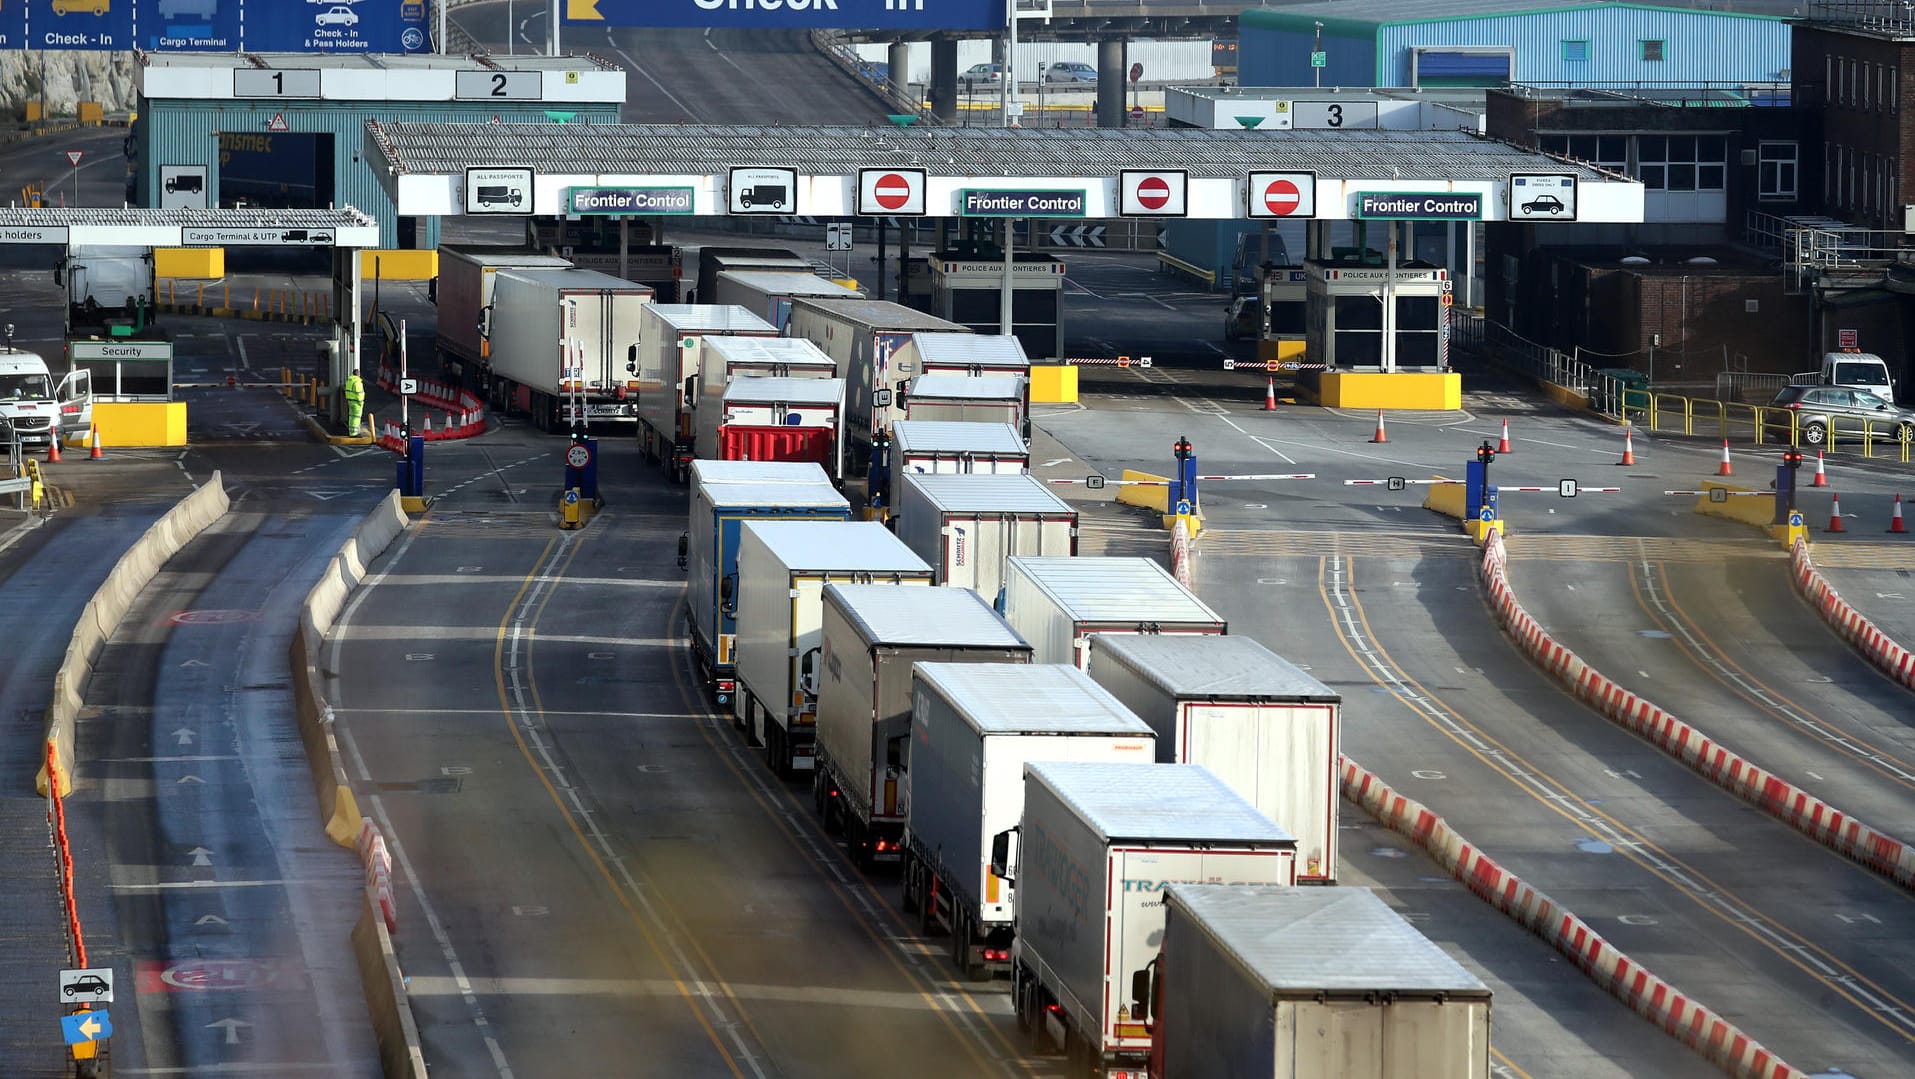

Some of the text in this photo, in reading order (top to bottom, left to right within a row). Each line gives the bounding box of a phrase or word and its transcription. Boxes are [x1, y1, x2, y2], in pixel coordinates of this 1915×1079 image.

[45, 33, 87, 45] Check
[100, 34, 113, 45] In
[314, 29, 343, 38] Check
[350, 29, 359, 38] In
[159, 37, 227, 47] Cargo Terminal
[304, 39, 369, 48] & Pass Holders
[272, 71, 283, 94] 1
[491, 73, 507, 97] 2
[1327, 104, 1343, 127] 3
[575, 193, 690, 208] Frontier Control
[967, 195, 1081, 210] Frontier Control
[1363, 198, 1478, 213] Frontier Control
[5, 230, 42, 240] holders
[189, 232, 278, 241] Cargo Terminal & UTP
[673, 249, 680, 258] 2
[102, 346, 142, 358] Security
[404, 382, 413, 390] A
